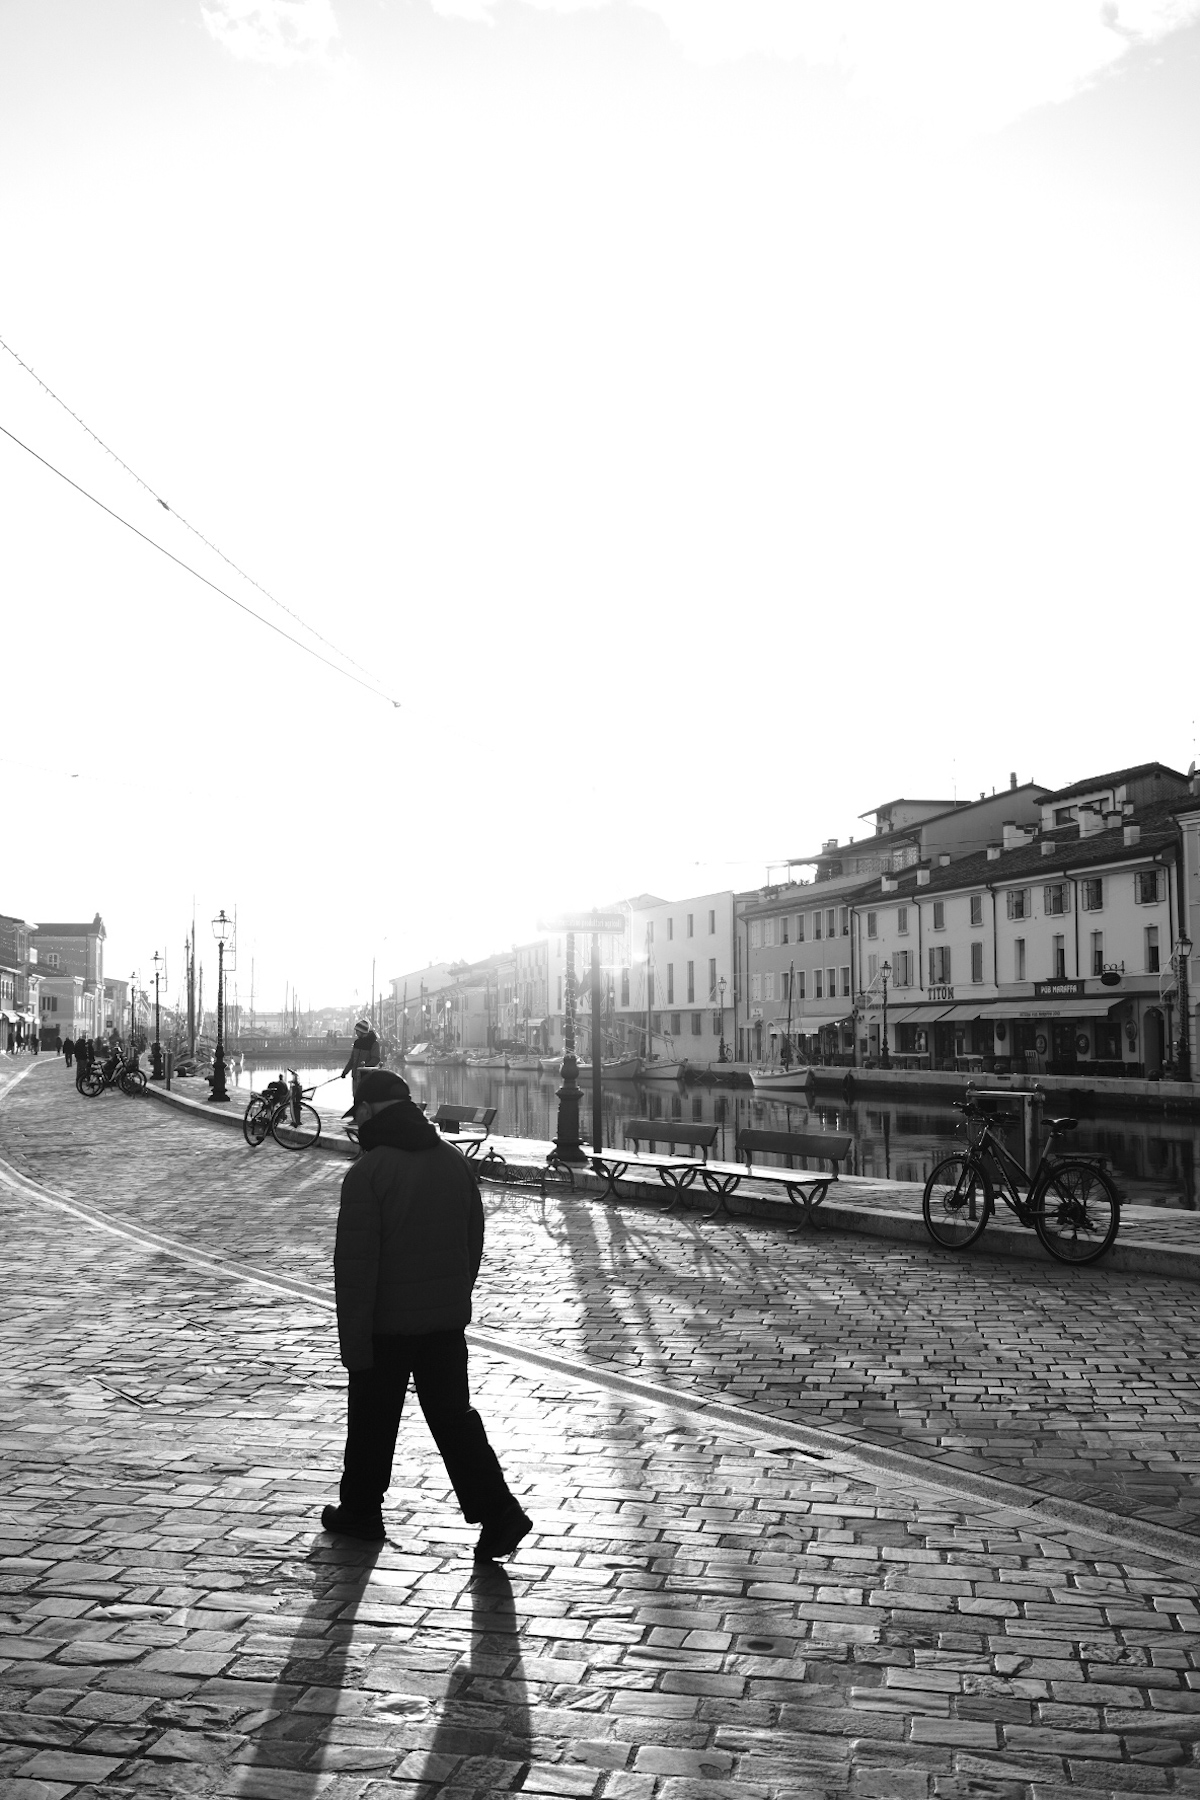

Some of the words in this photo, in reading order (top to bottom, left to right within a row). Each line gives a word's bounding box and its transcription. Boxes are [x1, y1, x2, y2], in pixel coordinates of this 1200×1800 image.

[927, 986, 955, 1000] TITON
[1040, 985, 1052, 994] PUB
[1052, 984, 1078, 994] MARAFFA
